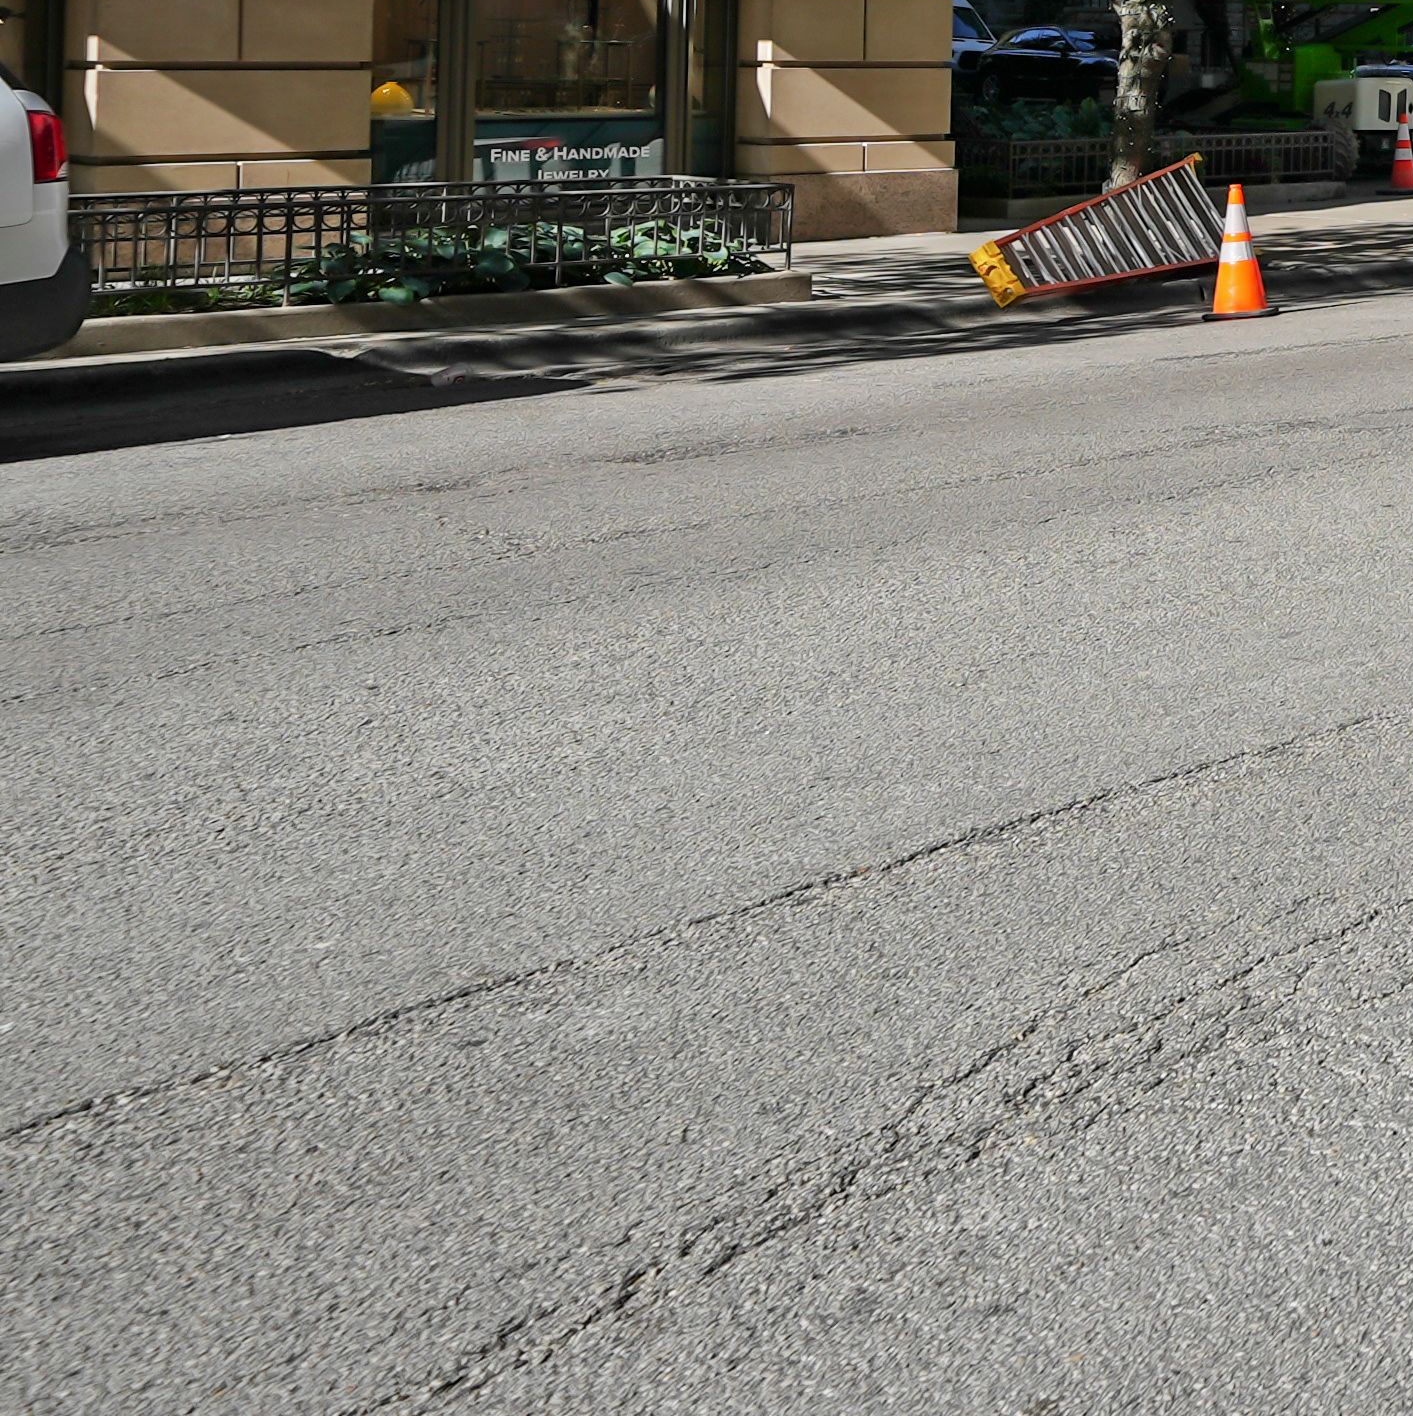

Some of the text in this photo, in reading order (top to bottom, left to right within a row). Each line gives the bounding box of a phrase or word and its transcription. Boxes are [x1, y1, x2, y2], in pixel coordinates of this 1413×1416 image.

[1323, 101, 1353, 119] 4x4
[490, 145, 651, 163] FINE & HANDMADE
